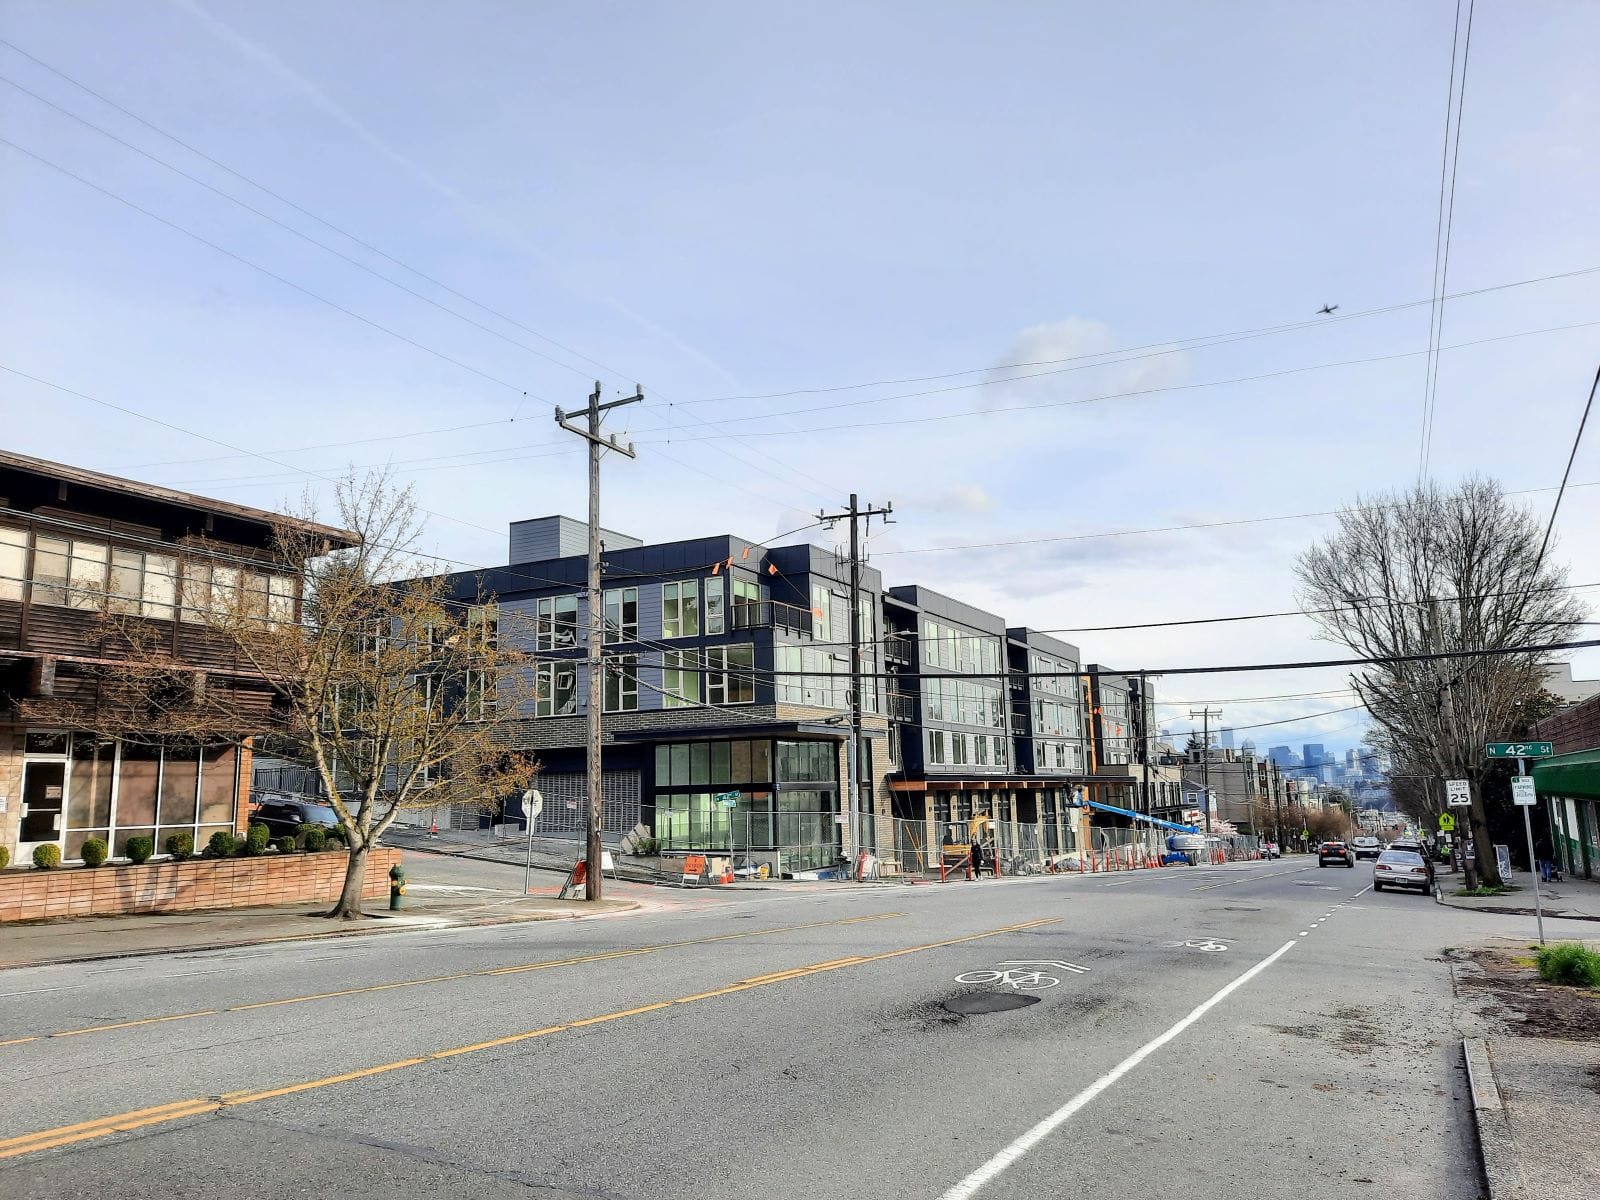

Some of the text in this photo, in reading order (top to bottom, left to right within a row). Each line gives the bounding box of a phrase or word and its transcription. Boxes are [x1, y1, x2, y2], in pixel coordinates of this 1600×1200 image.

[1489, 744, 1550, 756] N 42nd St
[1450, 793, 1469, 803] 25
